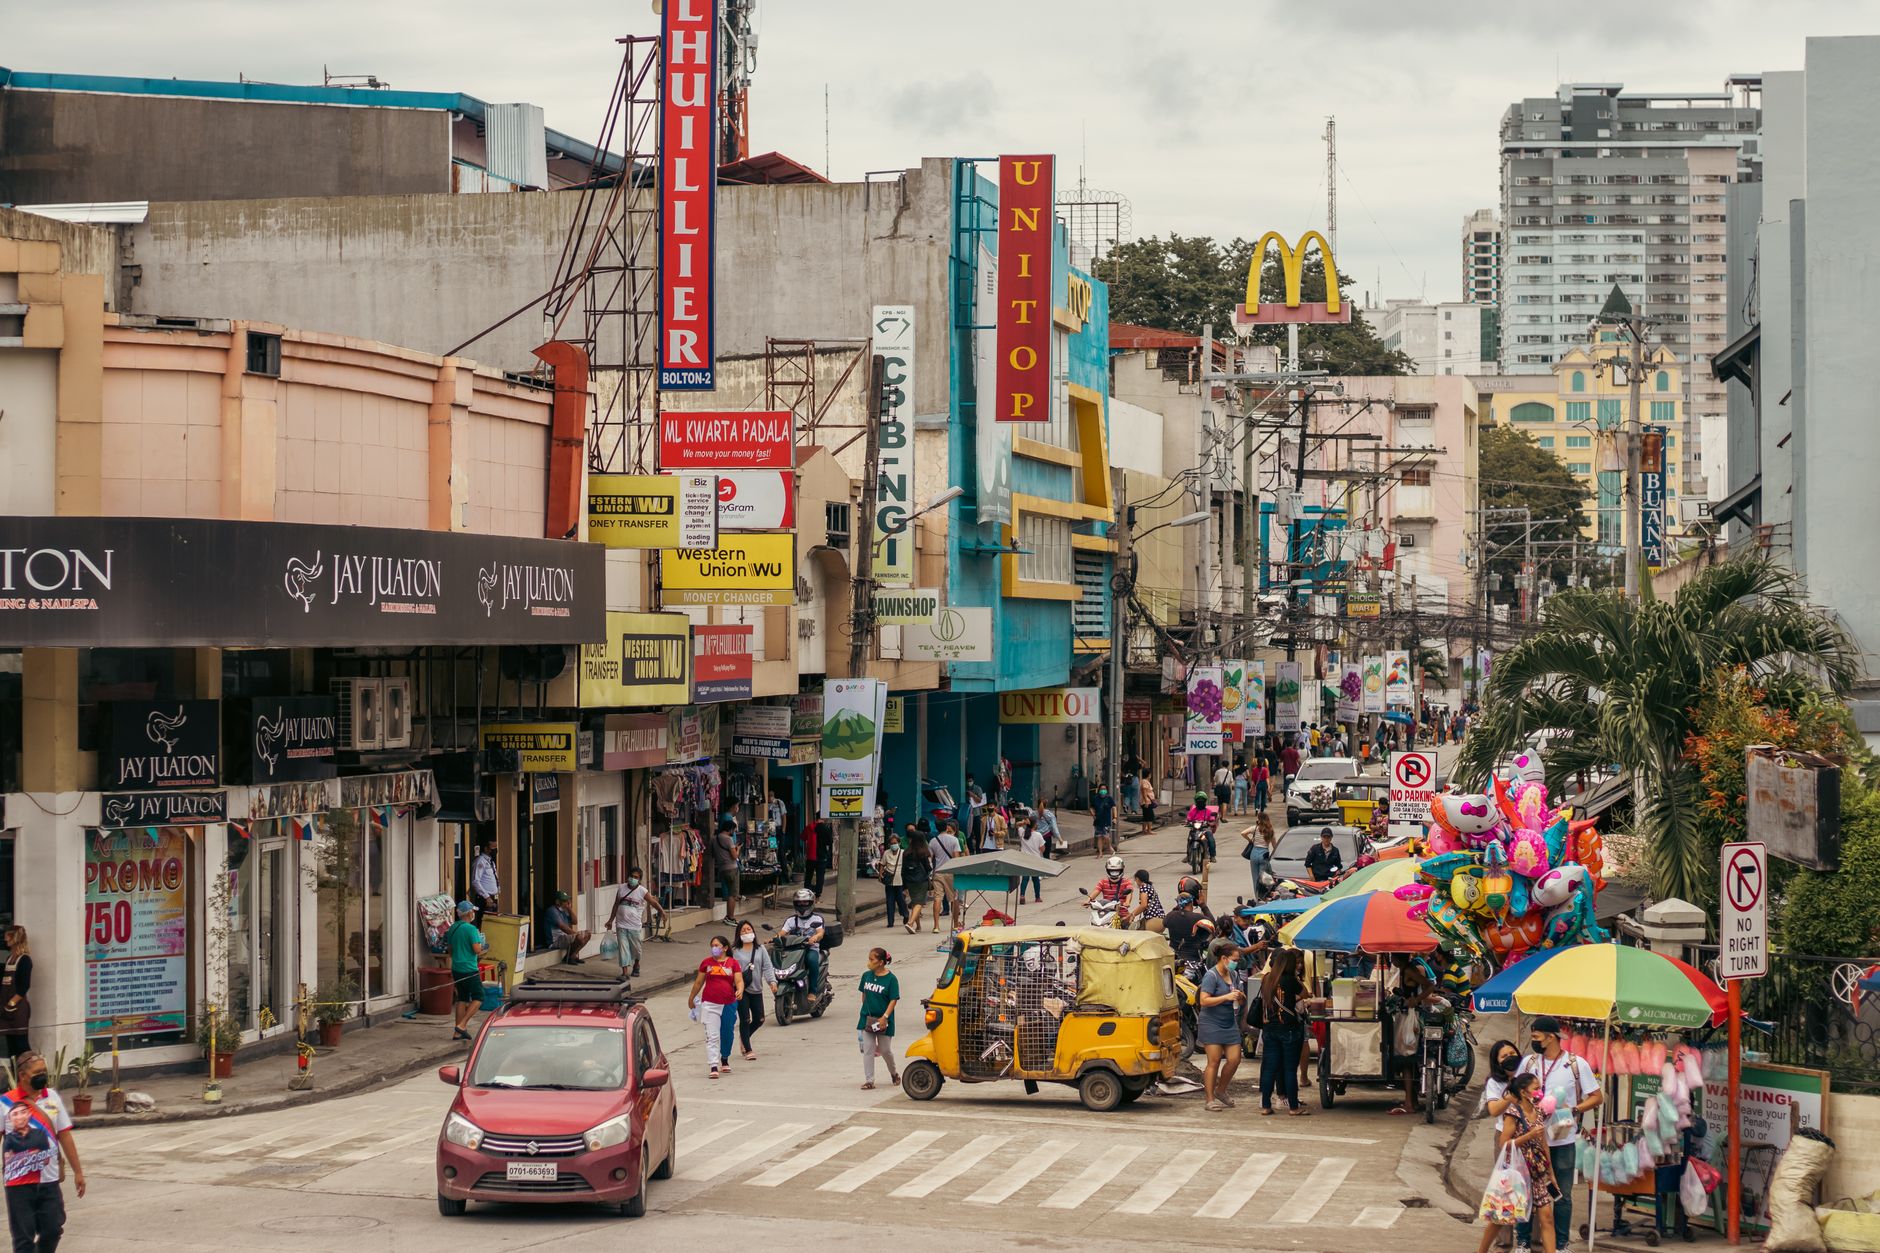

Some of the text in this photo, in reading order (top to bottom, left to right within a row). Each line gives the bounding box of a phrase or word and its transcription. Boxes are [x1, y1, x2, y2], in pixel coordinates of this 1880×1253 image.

[1009, 161, 1043, 417] UNITOP
[663, 371, 712, 385] BOLTON-2
[664, 418, 790, 444] ML KWARTA PADALA
[683, 448, 772, 460] We move your money fast!
[596, 505, 633, 513] UNION
[638, 496, 669, 513] WU
[687, 504, 709, 512] money
[589, 519, 669, 528] ONEY TRANSFER
[686, 533, 711, 541] loading
[676, 549, 746, 561] Western
[699, 562, 782, 577] Union WU
[331, 553, 441, 606] JAY JUATON
[501, 564, 574, 610] JAY JUATON
[40, 598, 99, 609] NAILSPA
[683, 592, 774, 603] MONEY CHANGER
[584, 643, 608, 658] MONEY
[624, 639, 684, 680] WESTERN WU
[584, 660, 619, 680] TRANSFER
[635, 659, 660, 680] UNION
[1000, 692, 1098, 718] UNITOP
[284, 716, 336, 747] JAY JUATON
[539, 734, 567, 750] WU
[742, 737, 781, 747] MEN'S JEWELRY
[1190, 740, 1218, 749] NCCC
[522, 754, 567, 763] TRANSFER
[734, 744, 750, 755] GOLD
[750, 745, 772, 757] REPAIR
[771, 747, 789, 758] SHOP
[118, 754, 216, 785] JAY JUATON
[831, 788, 863, 796] BOYSEN
[1391, 789, 1435, 802] NO PARKING
[140, 795, 223, 820] JAY JUATON
[85, 857, 184, 894] PROMO
[1737, 917, 1752, 932] NO
[1729, 936, 1760, 952] RIGHT
[1730, 955, 1758, 971] TURN
[1642, 1008, 1698, 1022] MICROMATIC
[1637, 1083, 1656, 1092] DAPAT
[1705, 1083, 1793, 1106] WANING!
[1706, 1099, 1720, 1110] Do
[1740, 1106, 1764, 1117] eave
[1766, 1107, 1787, 1120] your
[1743, 1115, 1774, 1130] Penalty:
[1757, 1132, 1767, 1141] or
[509, 1167, 555, 1176] 0701-663693
